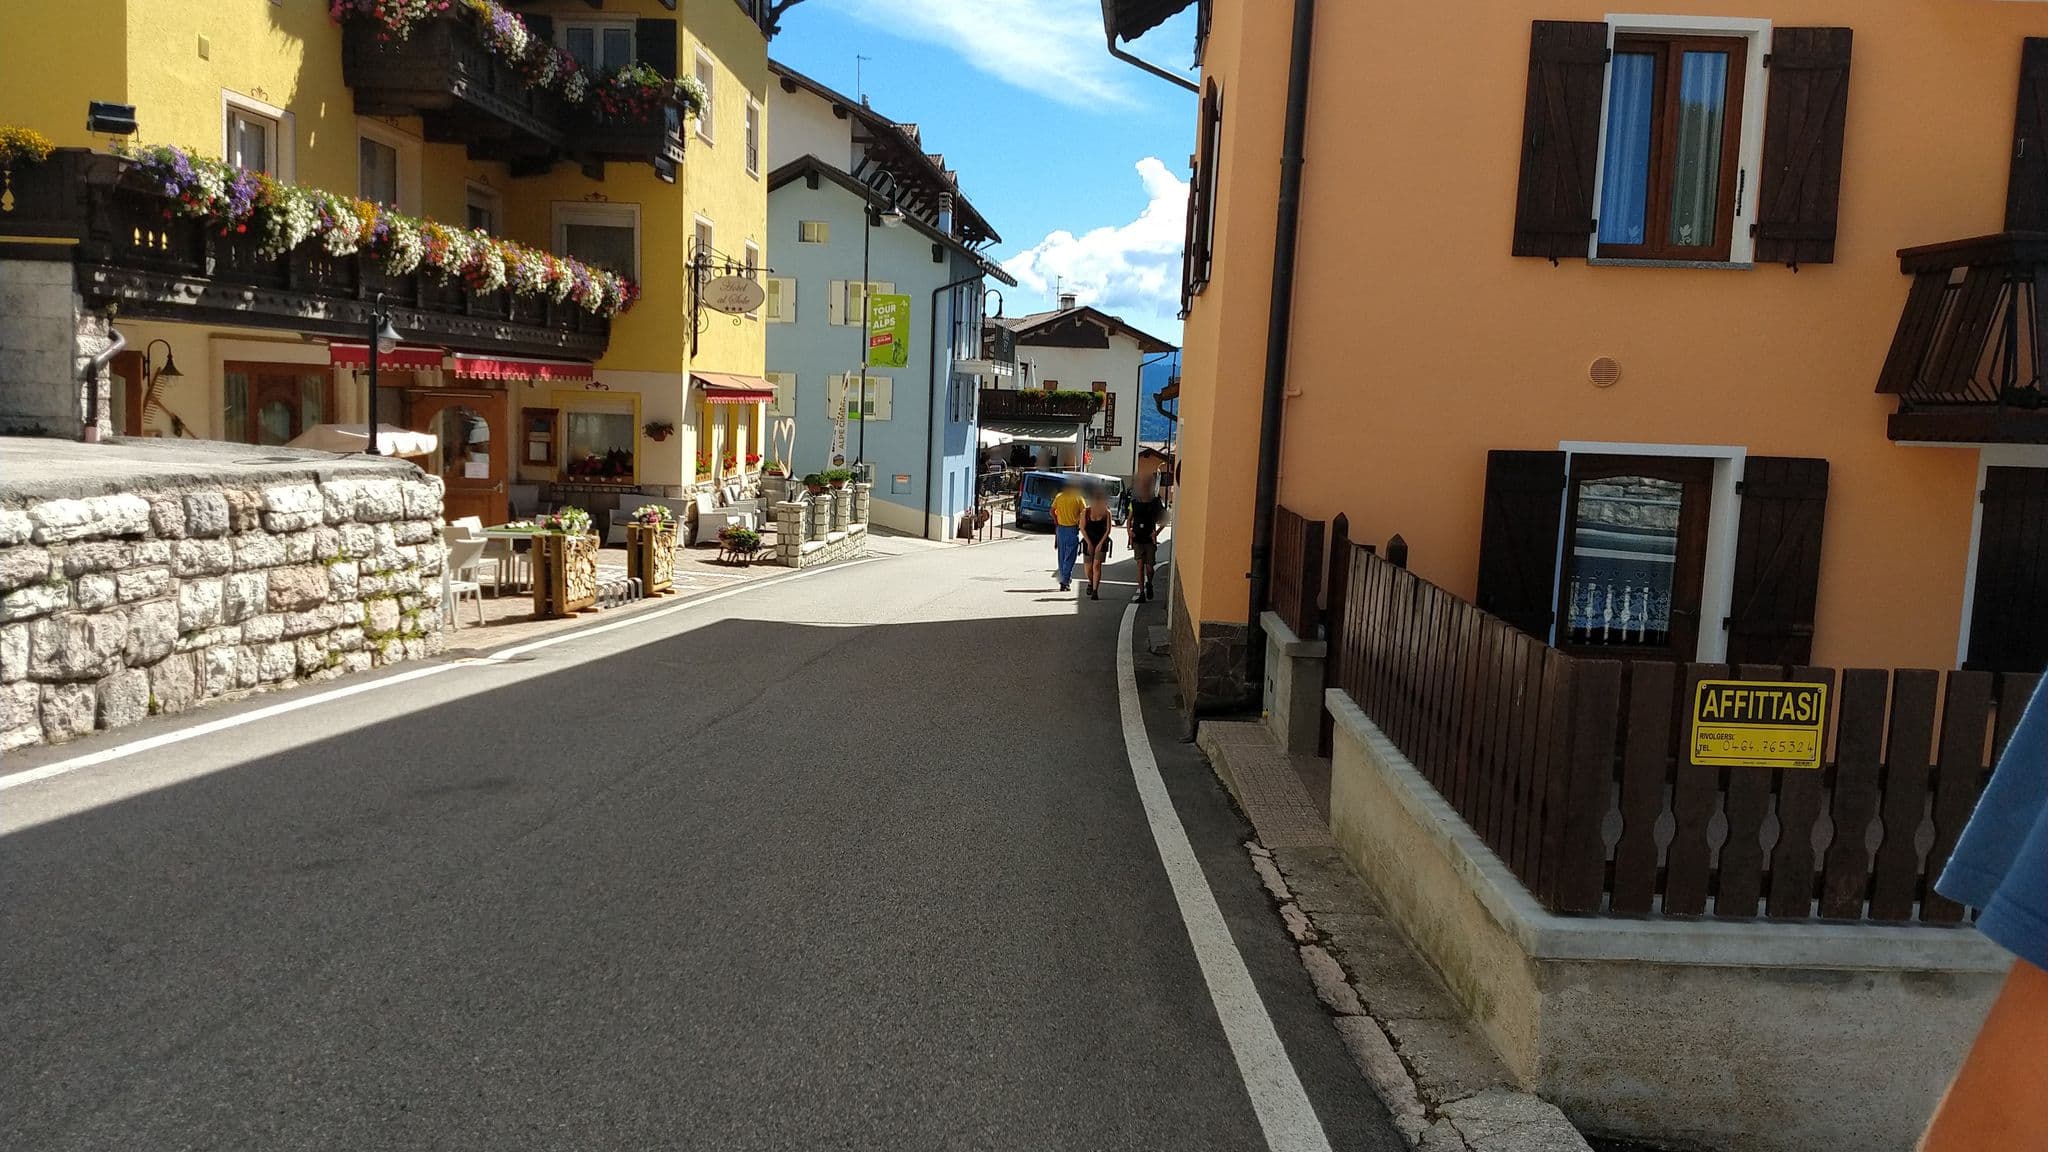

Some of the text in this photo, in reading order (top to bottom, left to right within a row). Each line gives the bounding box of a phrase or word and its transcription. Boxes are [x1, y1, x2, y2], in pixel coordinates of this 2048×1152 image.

[873, 304, 896, 316] TOUR
[872, 317, 896, 329] ALPS
[1702, 689, 1819, 721] AFFITTASI
